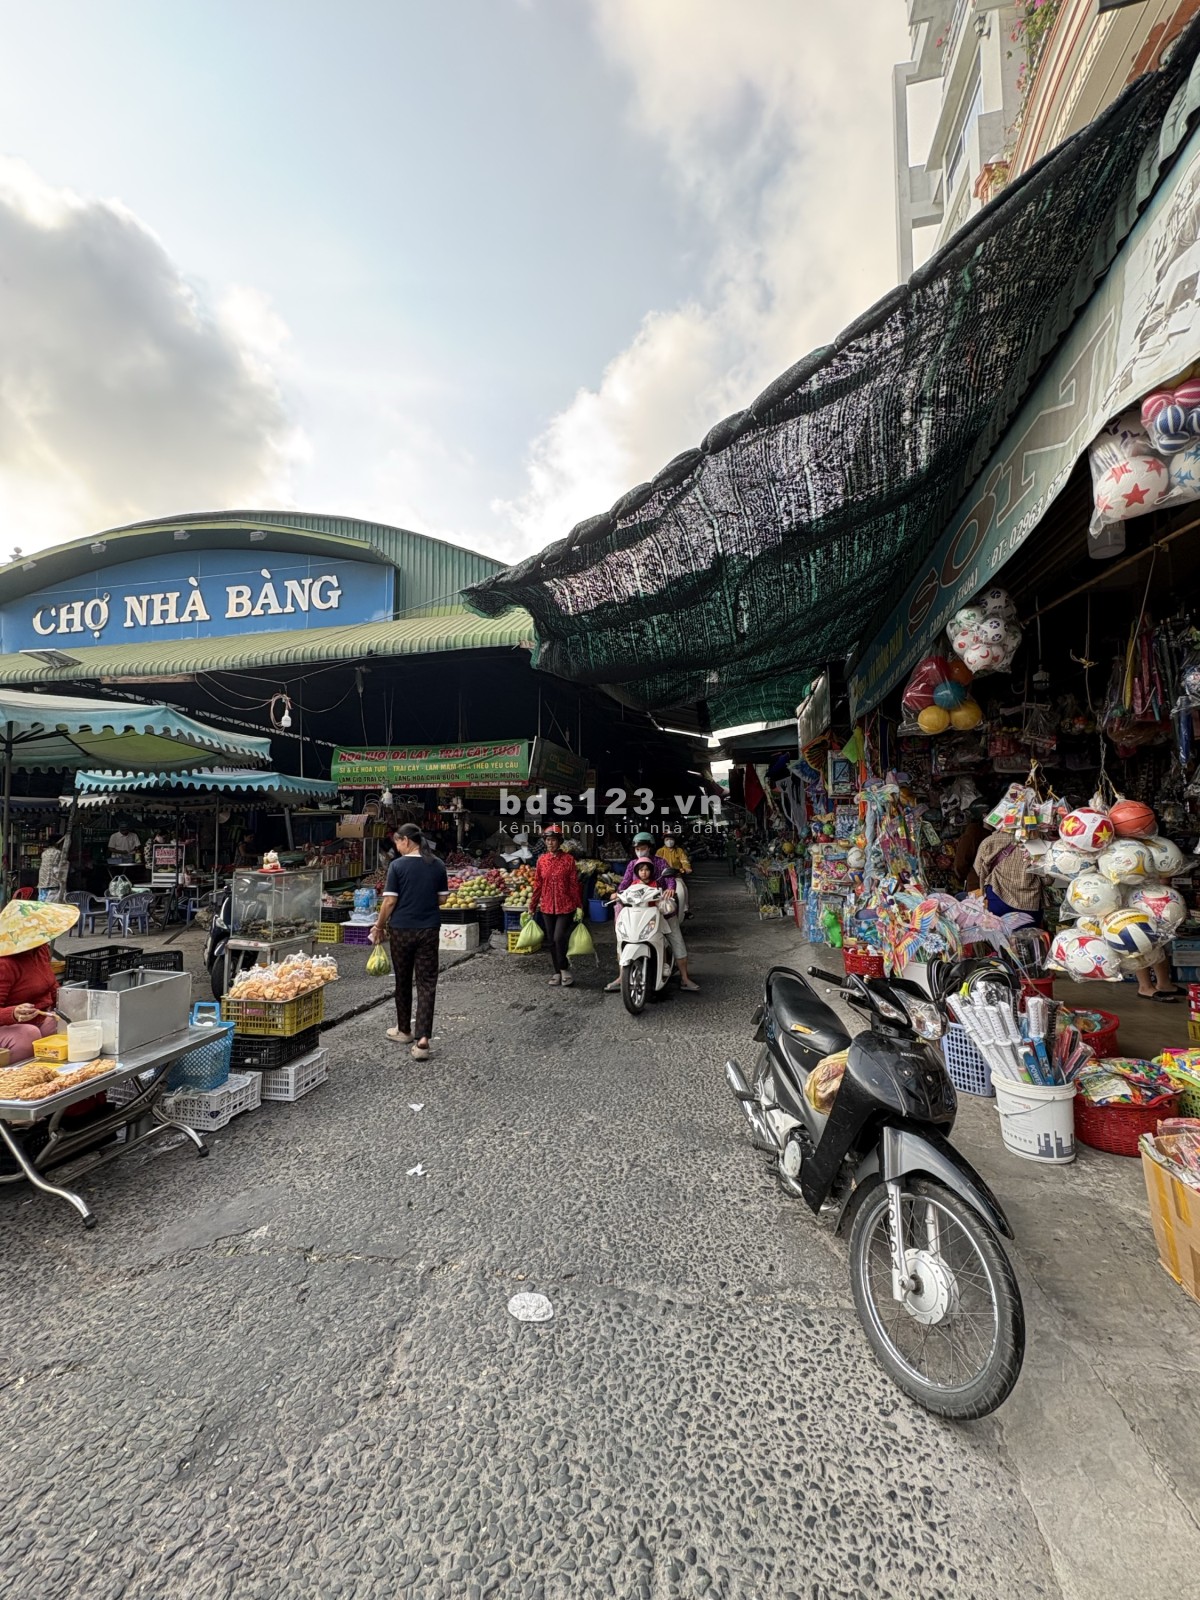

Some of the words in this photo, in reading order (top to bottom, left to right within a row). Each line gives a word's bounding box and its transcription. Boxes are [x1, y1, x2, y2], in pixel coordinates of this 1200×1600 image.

[32, 592, 110, 638] CHỢ
[123, 577, 210, 628] NHÀ
[225, 569, 343, 619] BÀNG
[339, 751, 362, 763] HOA
[361, 765, 373, 774] HOA
[473, 761, 489, 770] THEO
[491, 760, 504, 769] YÊU
[888, 1192, 900, 1271] HONDA
